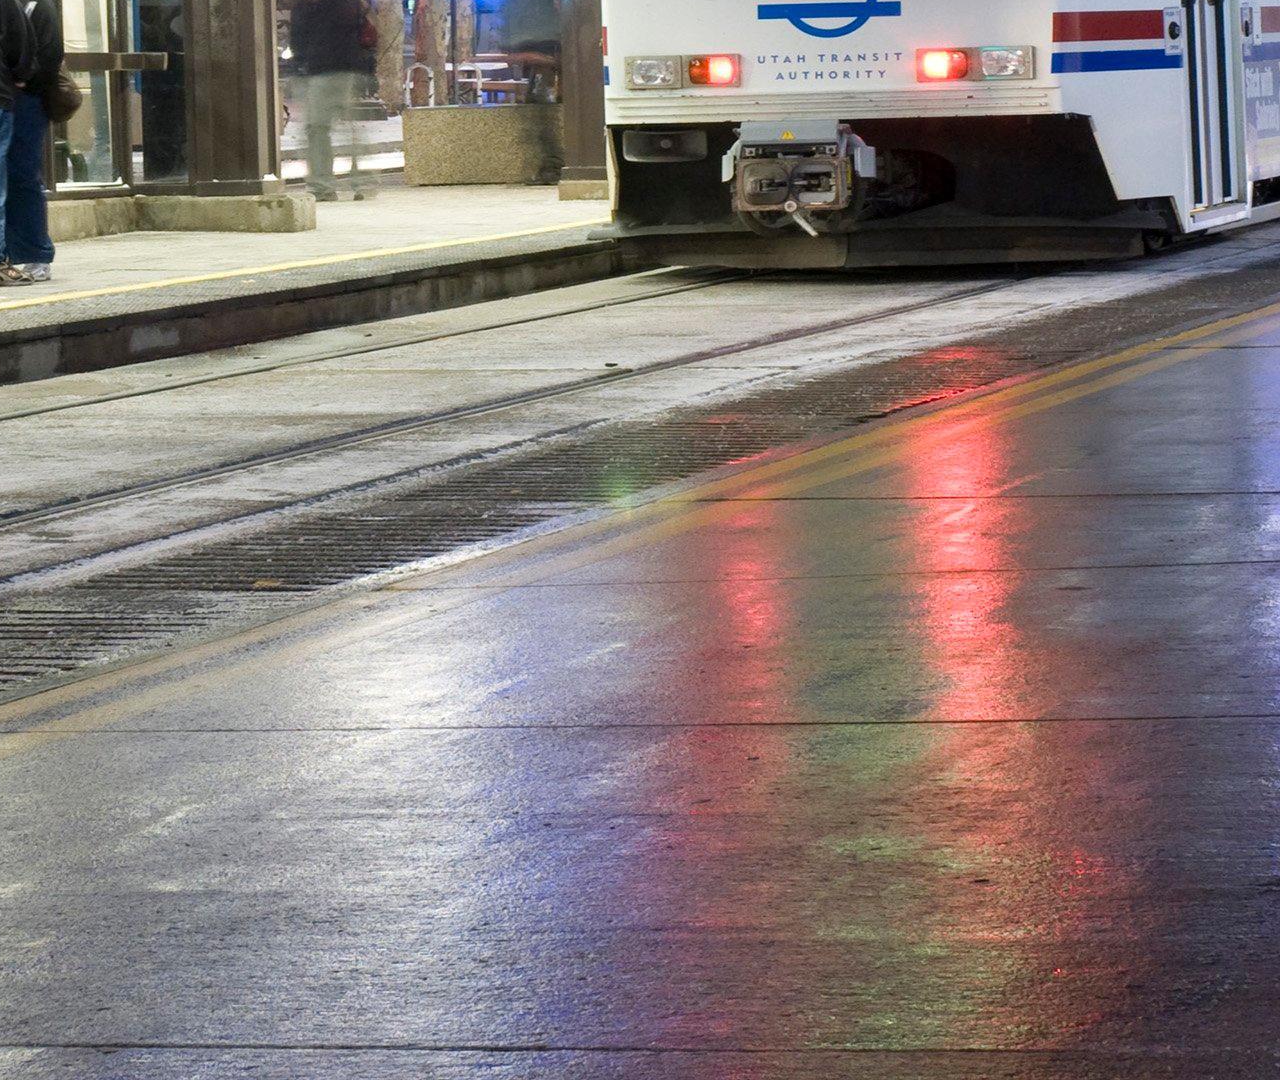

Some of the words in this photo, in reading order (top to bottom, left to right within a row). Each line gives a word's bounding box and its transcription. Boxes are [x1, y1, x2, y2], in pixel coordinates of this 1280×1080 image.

[757, 54, 806, 64] UTAH
[818, 52, 903, 63] TRANSIT
[776, 70, 887, 80] AUTHORITY
